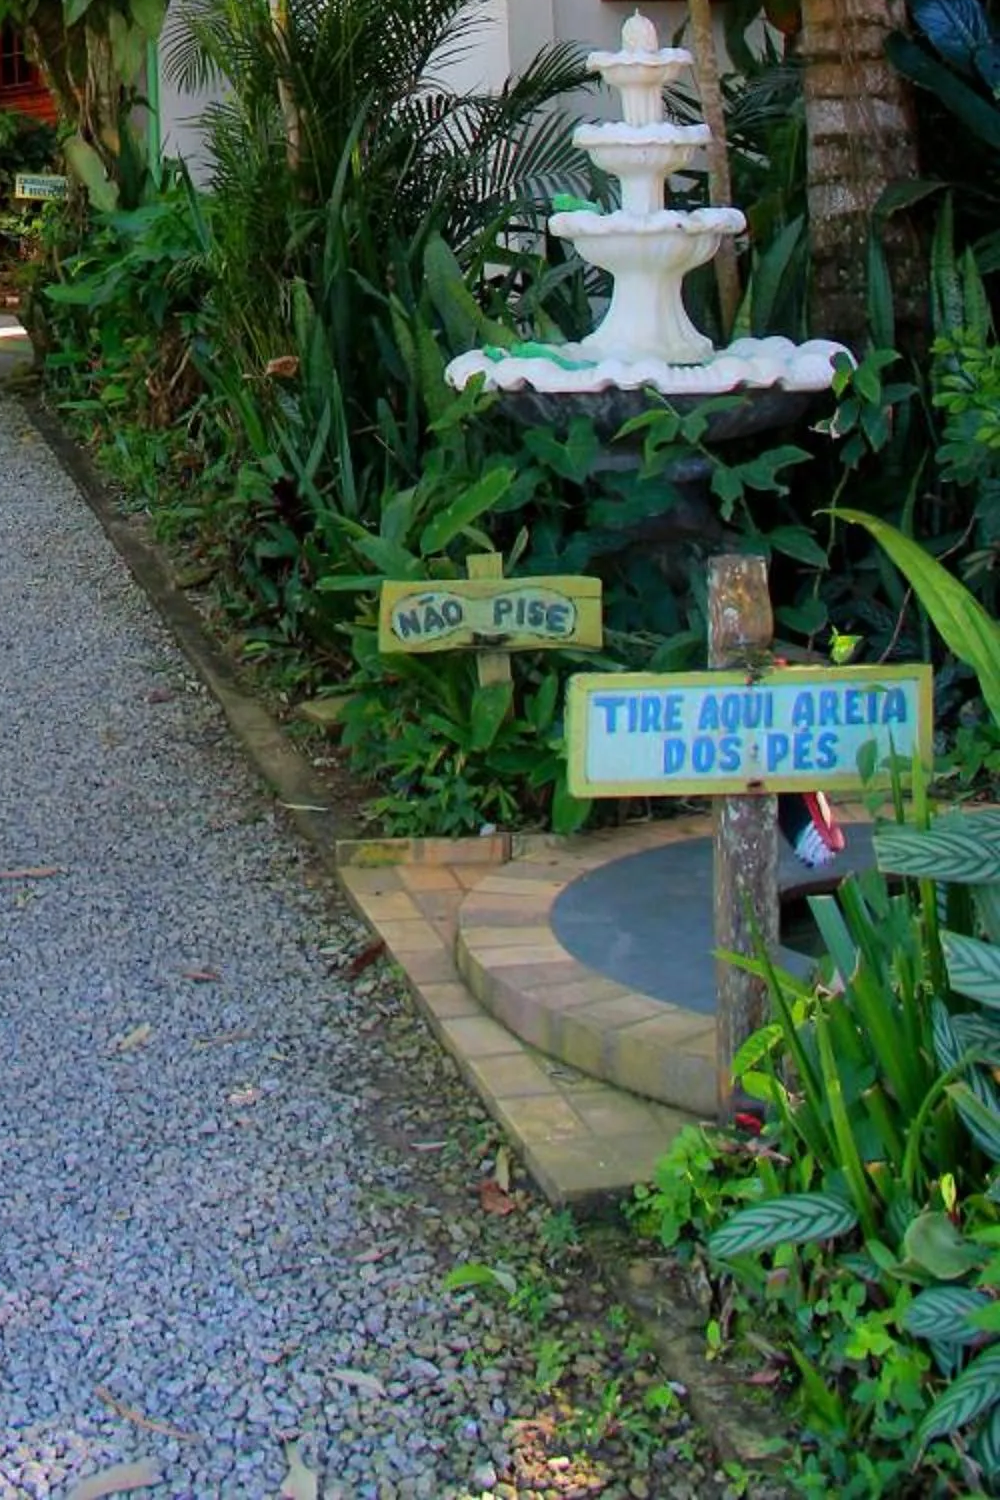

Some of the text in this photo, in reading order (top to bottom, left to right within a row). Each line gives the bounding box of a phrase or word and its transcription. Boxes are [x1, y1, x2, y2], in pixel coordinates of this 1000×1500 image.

[398, 596, 569, 637] NÃO PISE
[593, 686, 907, 734] TIRE AQUI AREIA
[663, 724, 839, 774] DOS PÉS
